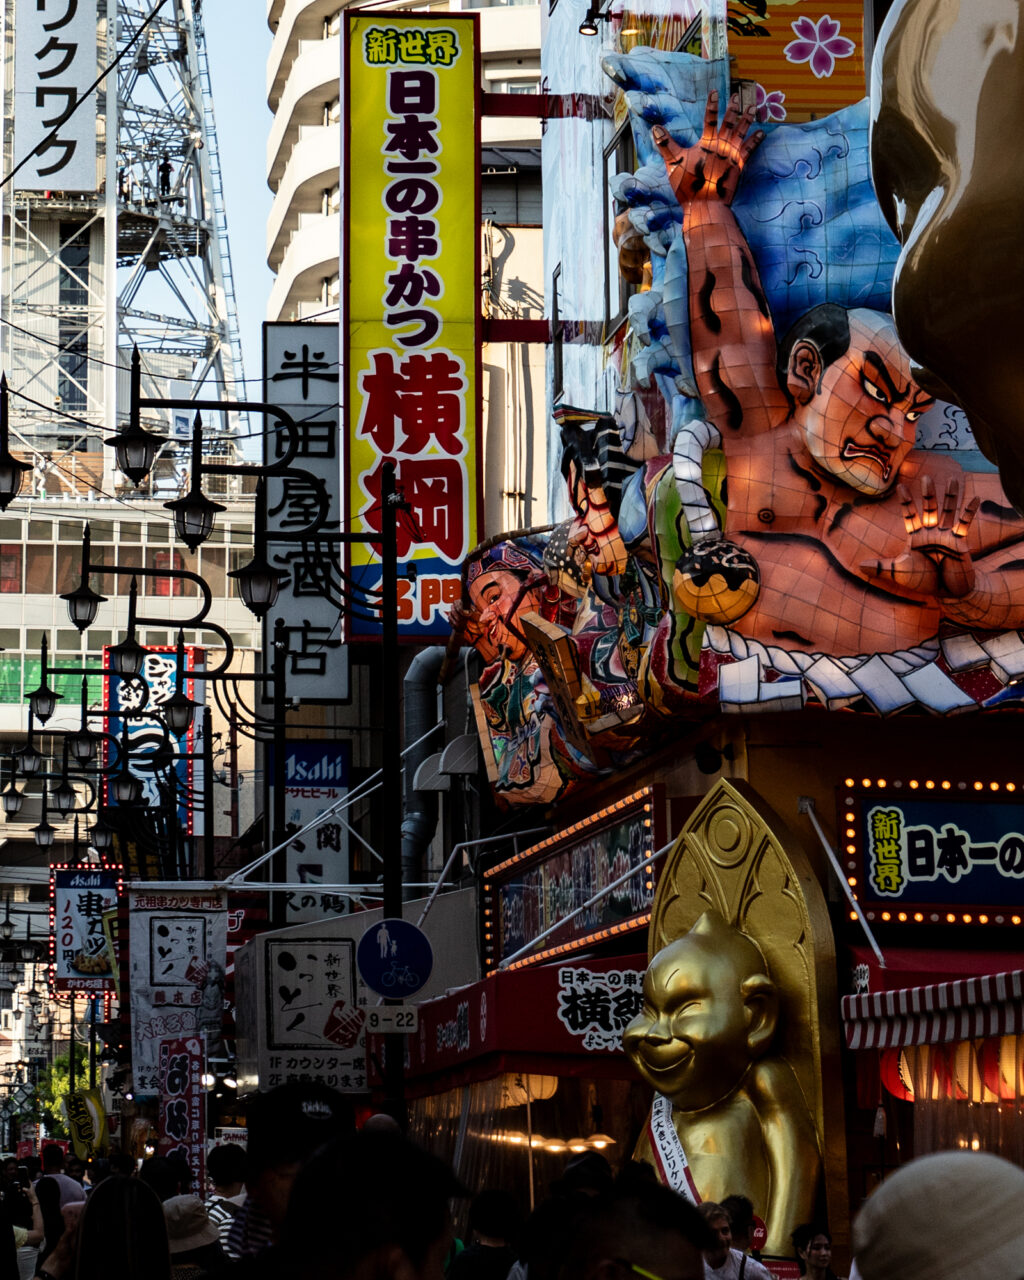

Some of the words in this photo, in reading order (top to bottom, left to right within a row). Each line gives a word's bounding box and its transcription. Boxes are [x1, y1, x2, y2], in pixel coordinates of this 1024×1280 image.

[367, 28, 458, 65] 新世界
[385, 70, 442, 347] 日本一の串かつ
[362, 352, 464, 560] 横綱
[872, 809, 903, 893] 新世界
[906, 827, 1024, 879] 日本一の
[69, 873, 102, 888] Asahi
[134, 895, 223, 909] 元祖串カツ専門店
[76, 890, 107, 956] 串カツ
[561, 970, 646, 985] 日本一の串
[369, 1012, 414, 1027] 9-22
[270, 1057, 282, 1068] 1F
[269, 1075, 282, 1086] 2F
